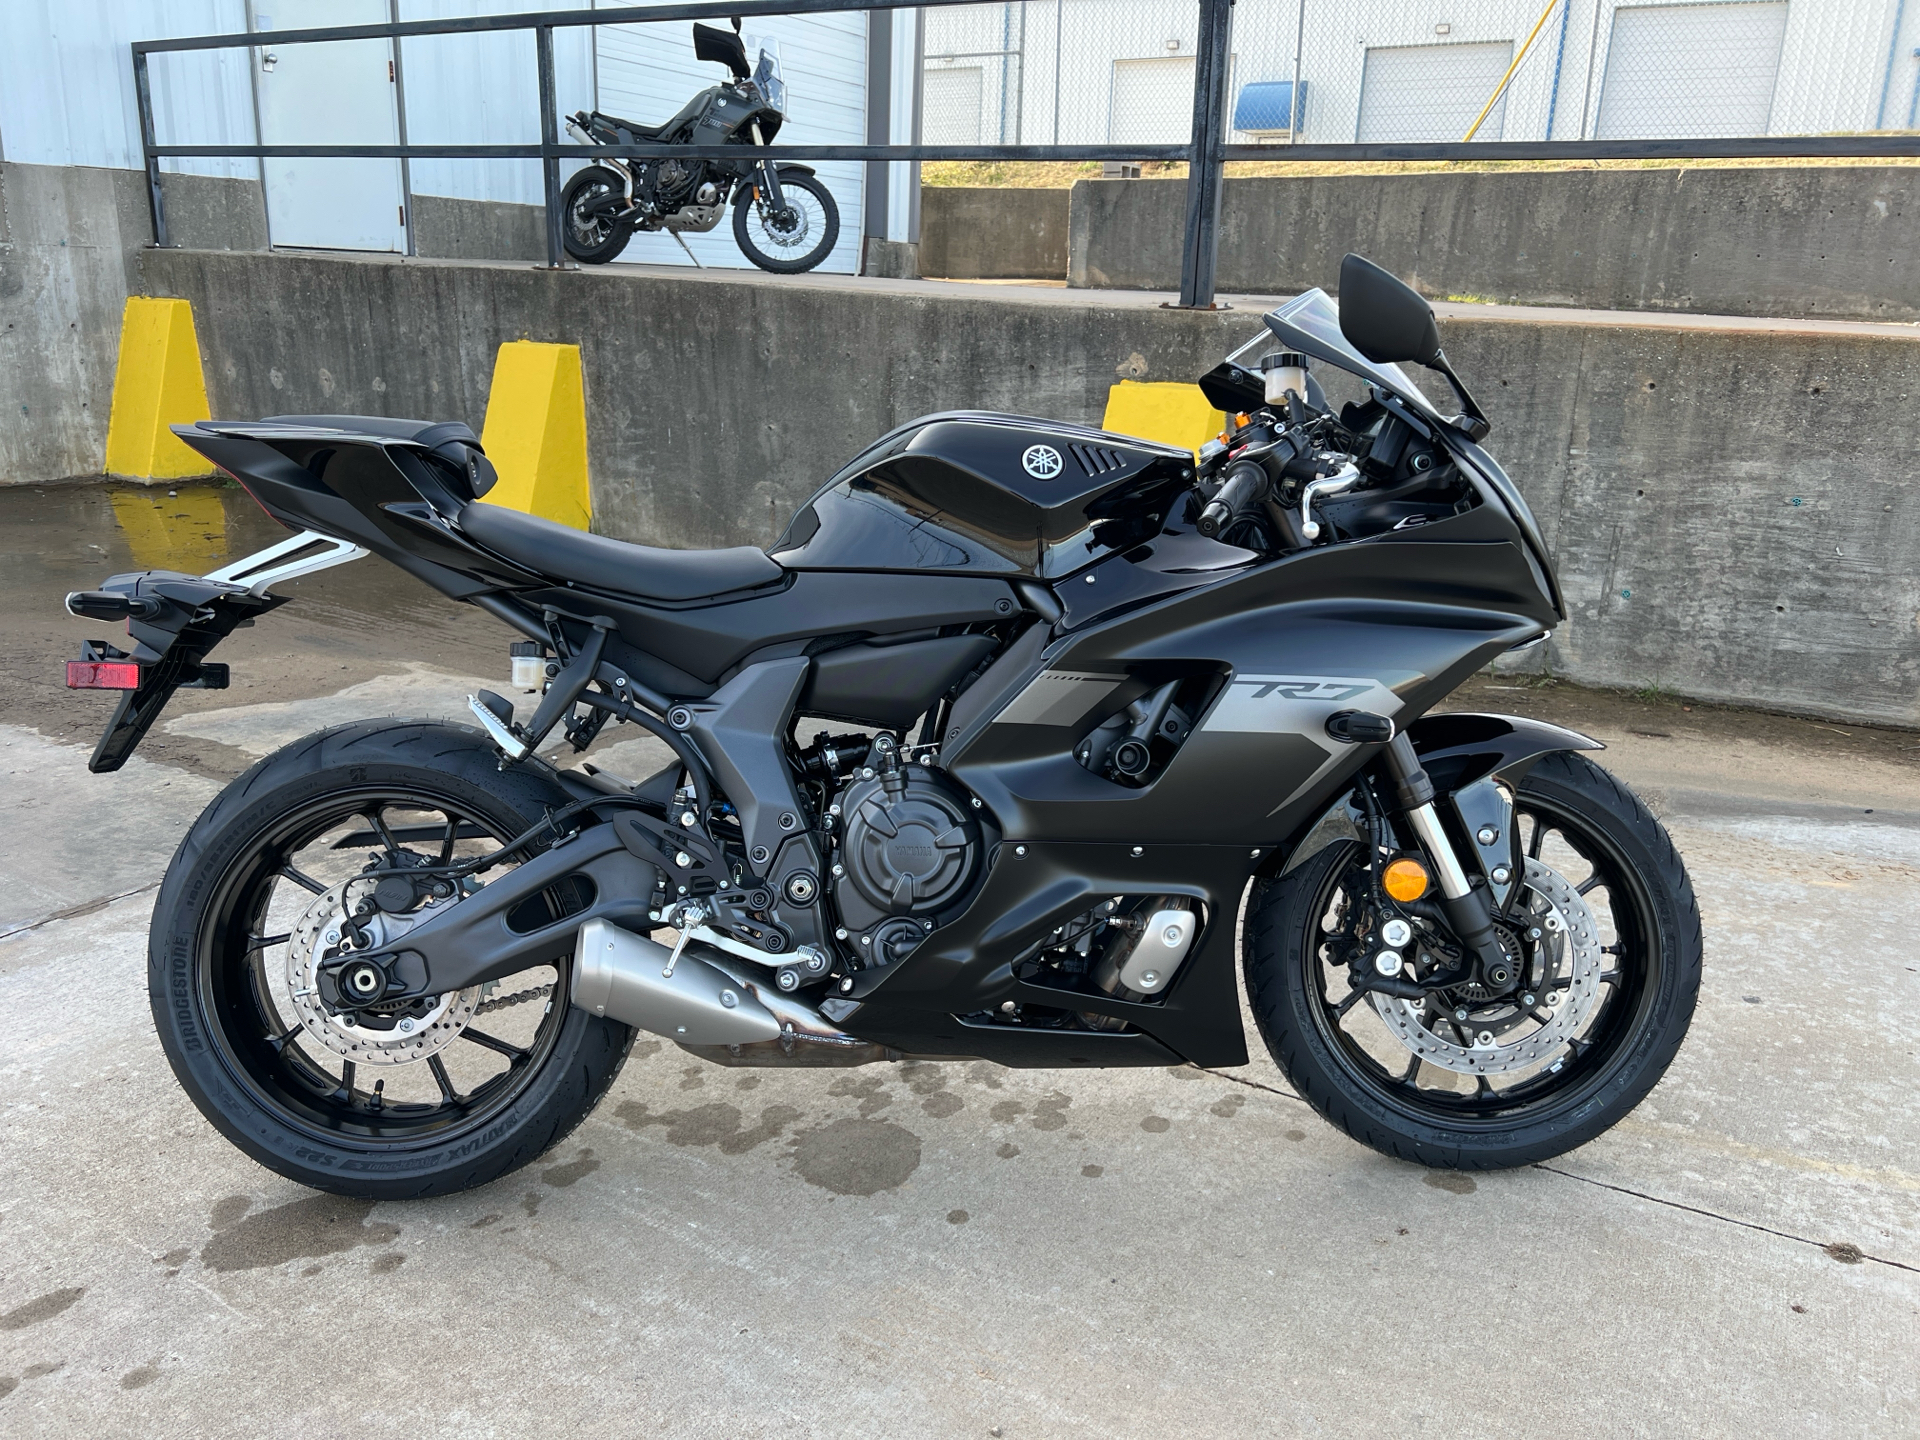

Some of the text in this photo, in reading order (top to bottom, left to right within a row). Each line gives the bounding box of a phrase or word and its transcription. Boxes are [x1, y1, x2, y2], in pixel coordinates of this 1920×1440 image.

[1249, 681, 1375, 701] R7
[895, 845, 932, 857] YAMAHA
[172, 935, 202, 1052] BRIDGESTONE
